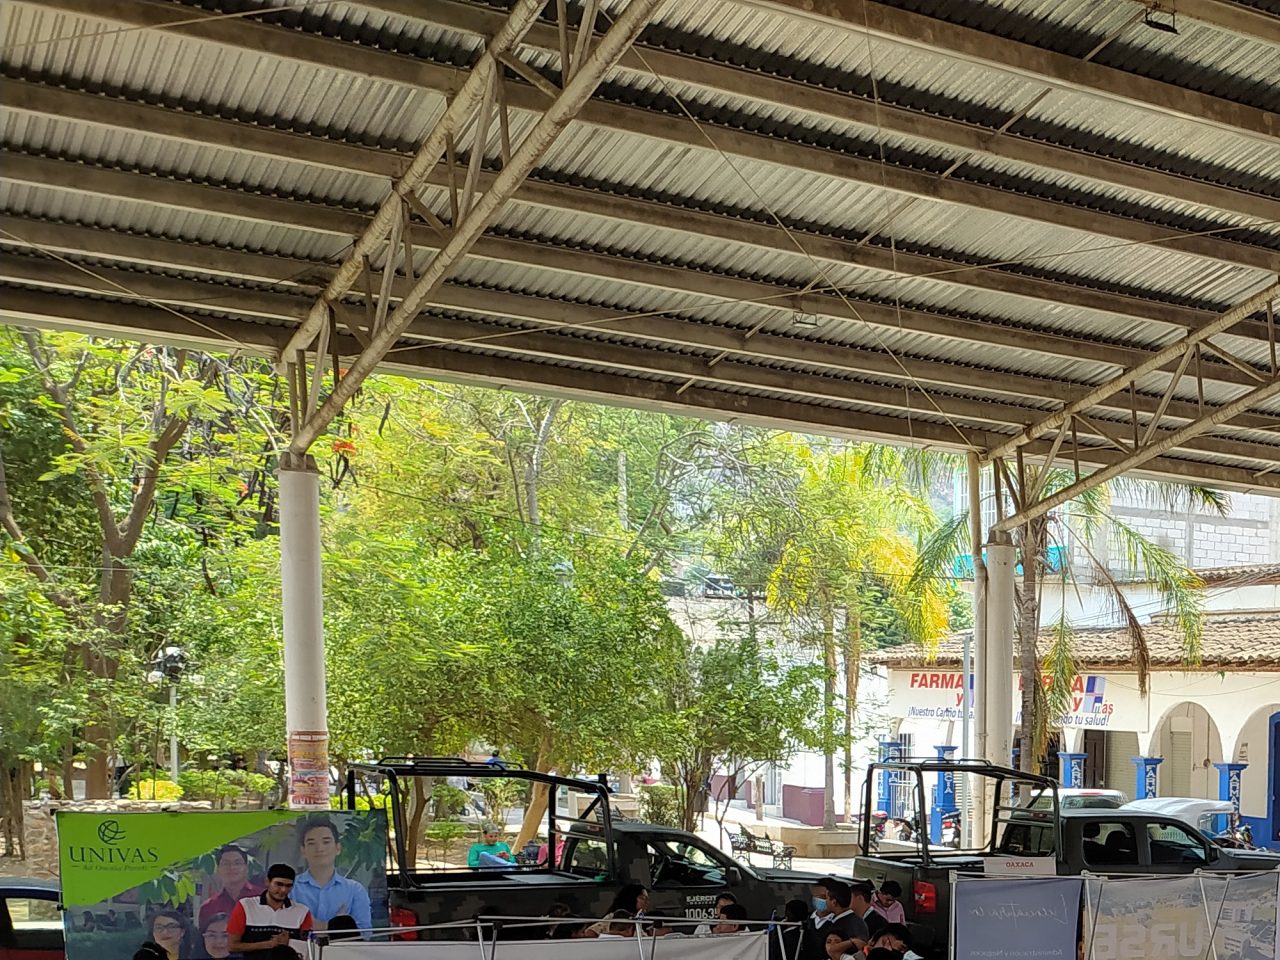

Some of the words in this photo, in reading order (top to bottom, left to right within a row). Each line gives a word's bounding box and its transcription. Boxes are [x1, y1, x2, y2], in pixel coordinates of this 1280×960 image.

[1073, 696, 1083, 712] y
[1084, 714, 1110, 726] salud!
[69, 846, 158, 863] UNIVAS
